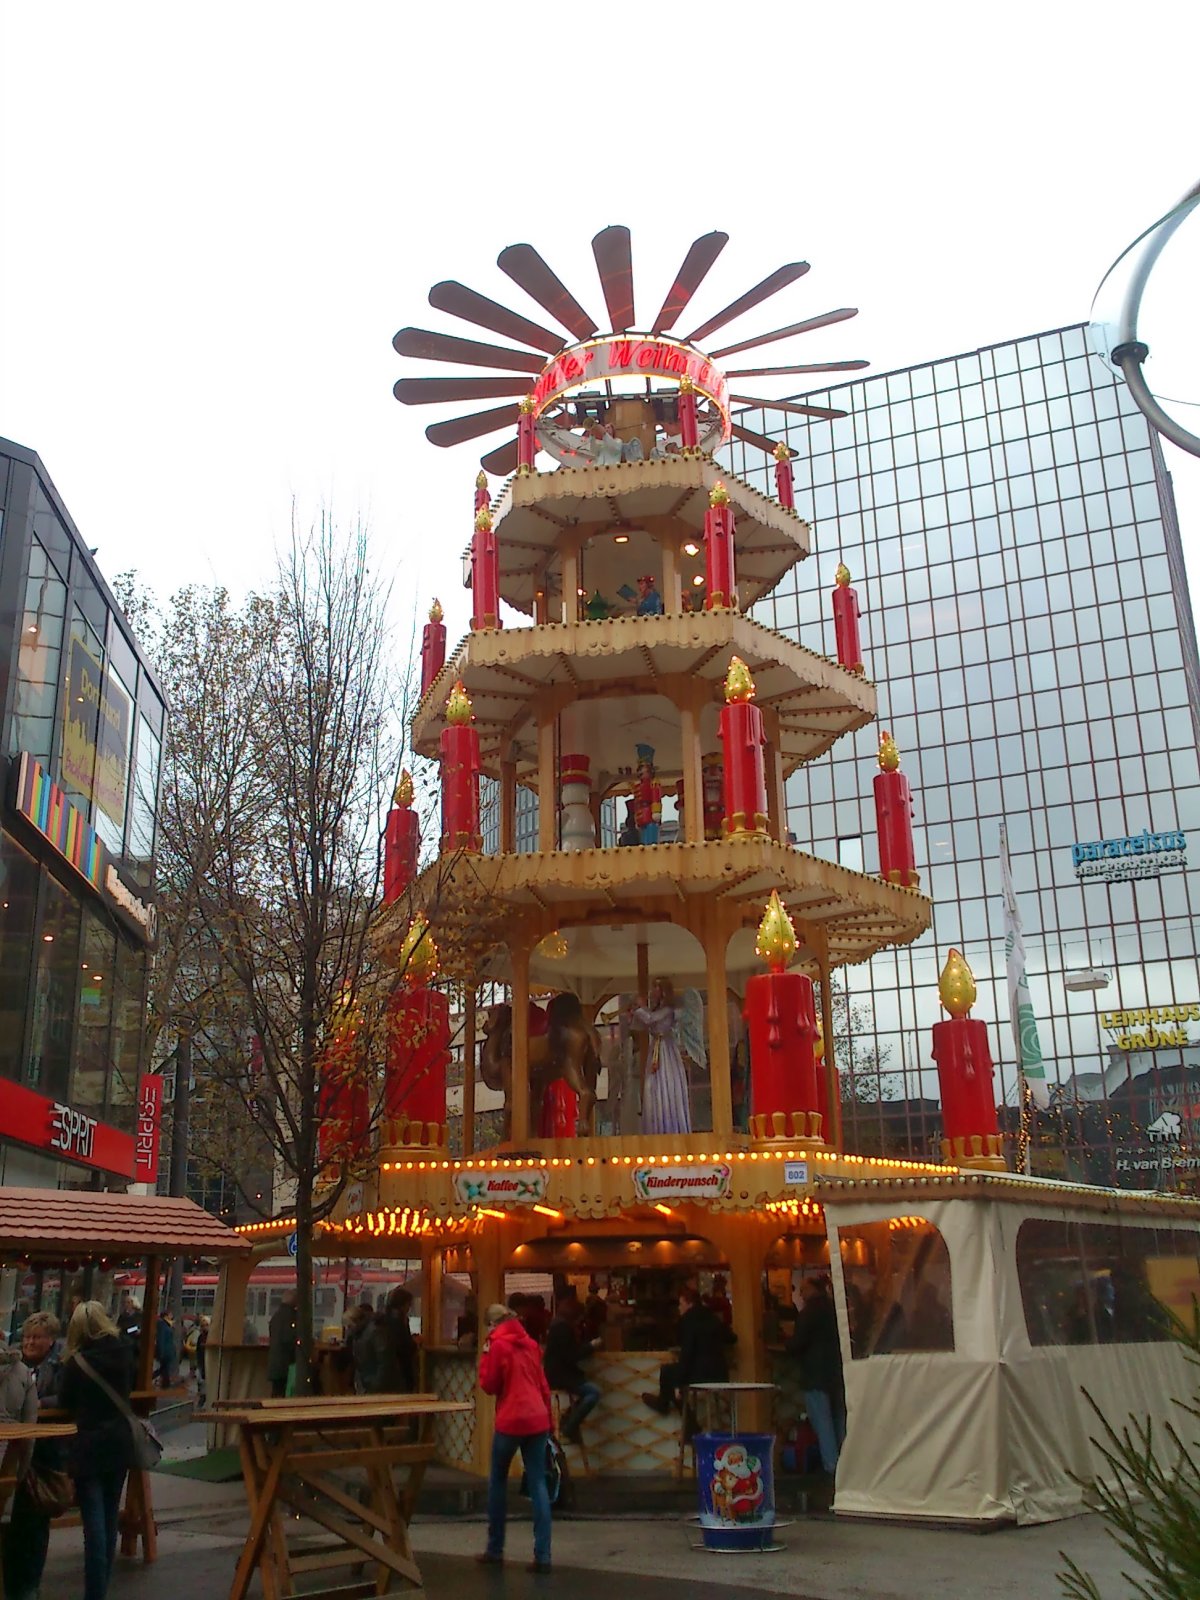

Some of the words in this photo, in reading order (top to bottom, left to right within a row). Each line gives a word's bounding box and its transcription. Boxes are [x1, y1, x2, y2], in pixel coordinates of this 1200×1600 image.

[1071, 828, 1187, 867] paracelsus
[1100, 1004, 1200, 1029] LEIHHAUS
[1117, 1027, 1189, 1050] GRÜNE
[51, 1102, 98, 1159] ESPRIT
[136, 1087, 157, 1169] ESPRIT
[788, 1170, 805, 1180] 802
[1133, 1160, 1158, 1171] van
[487, 1179, 519, 1192] Kaffee
[646, 1174, 719, 1189] Kinderpunsch
